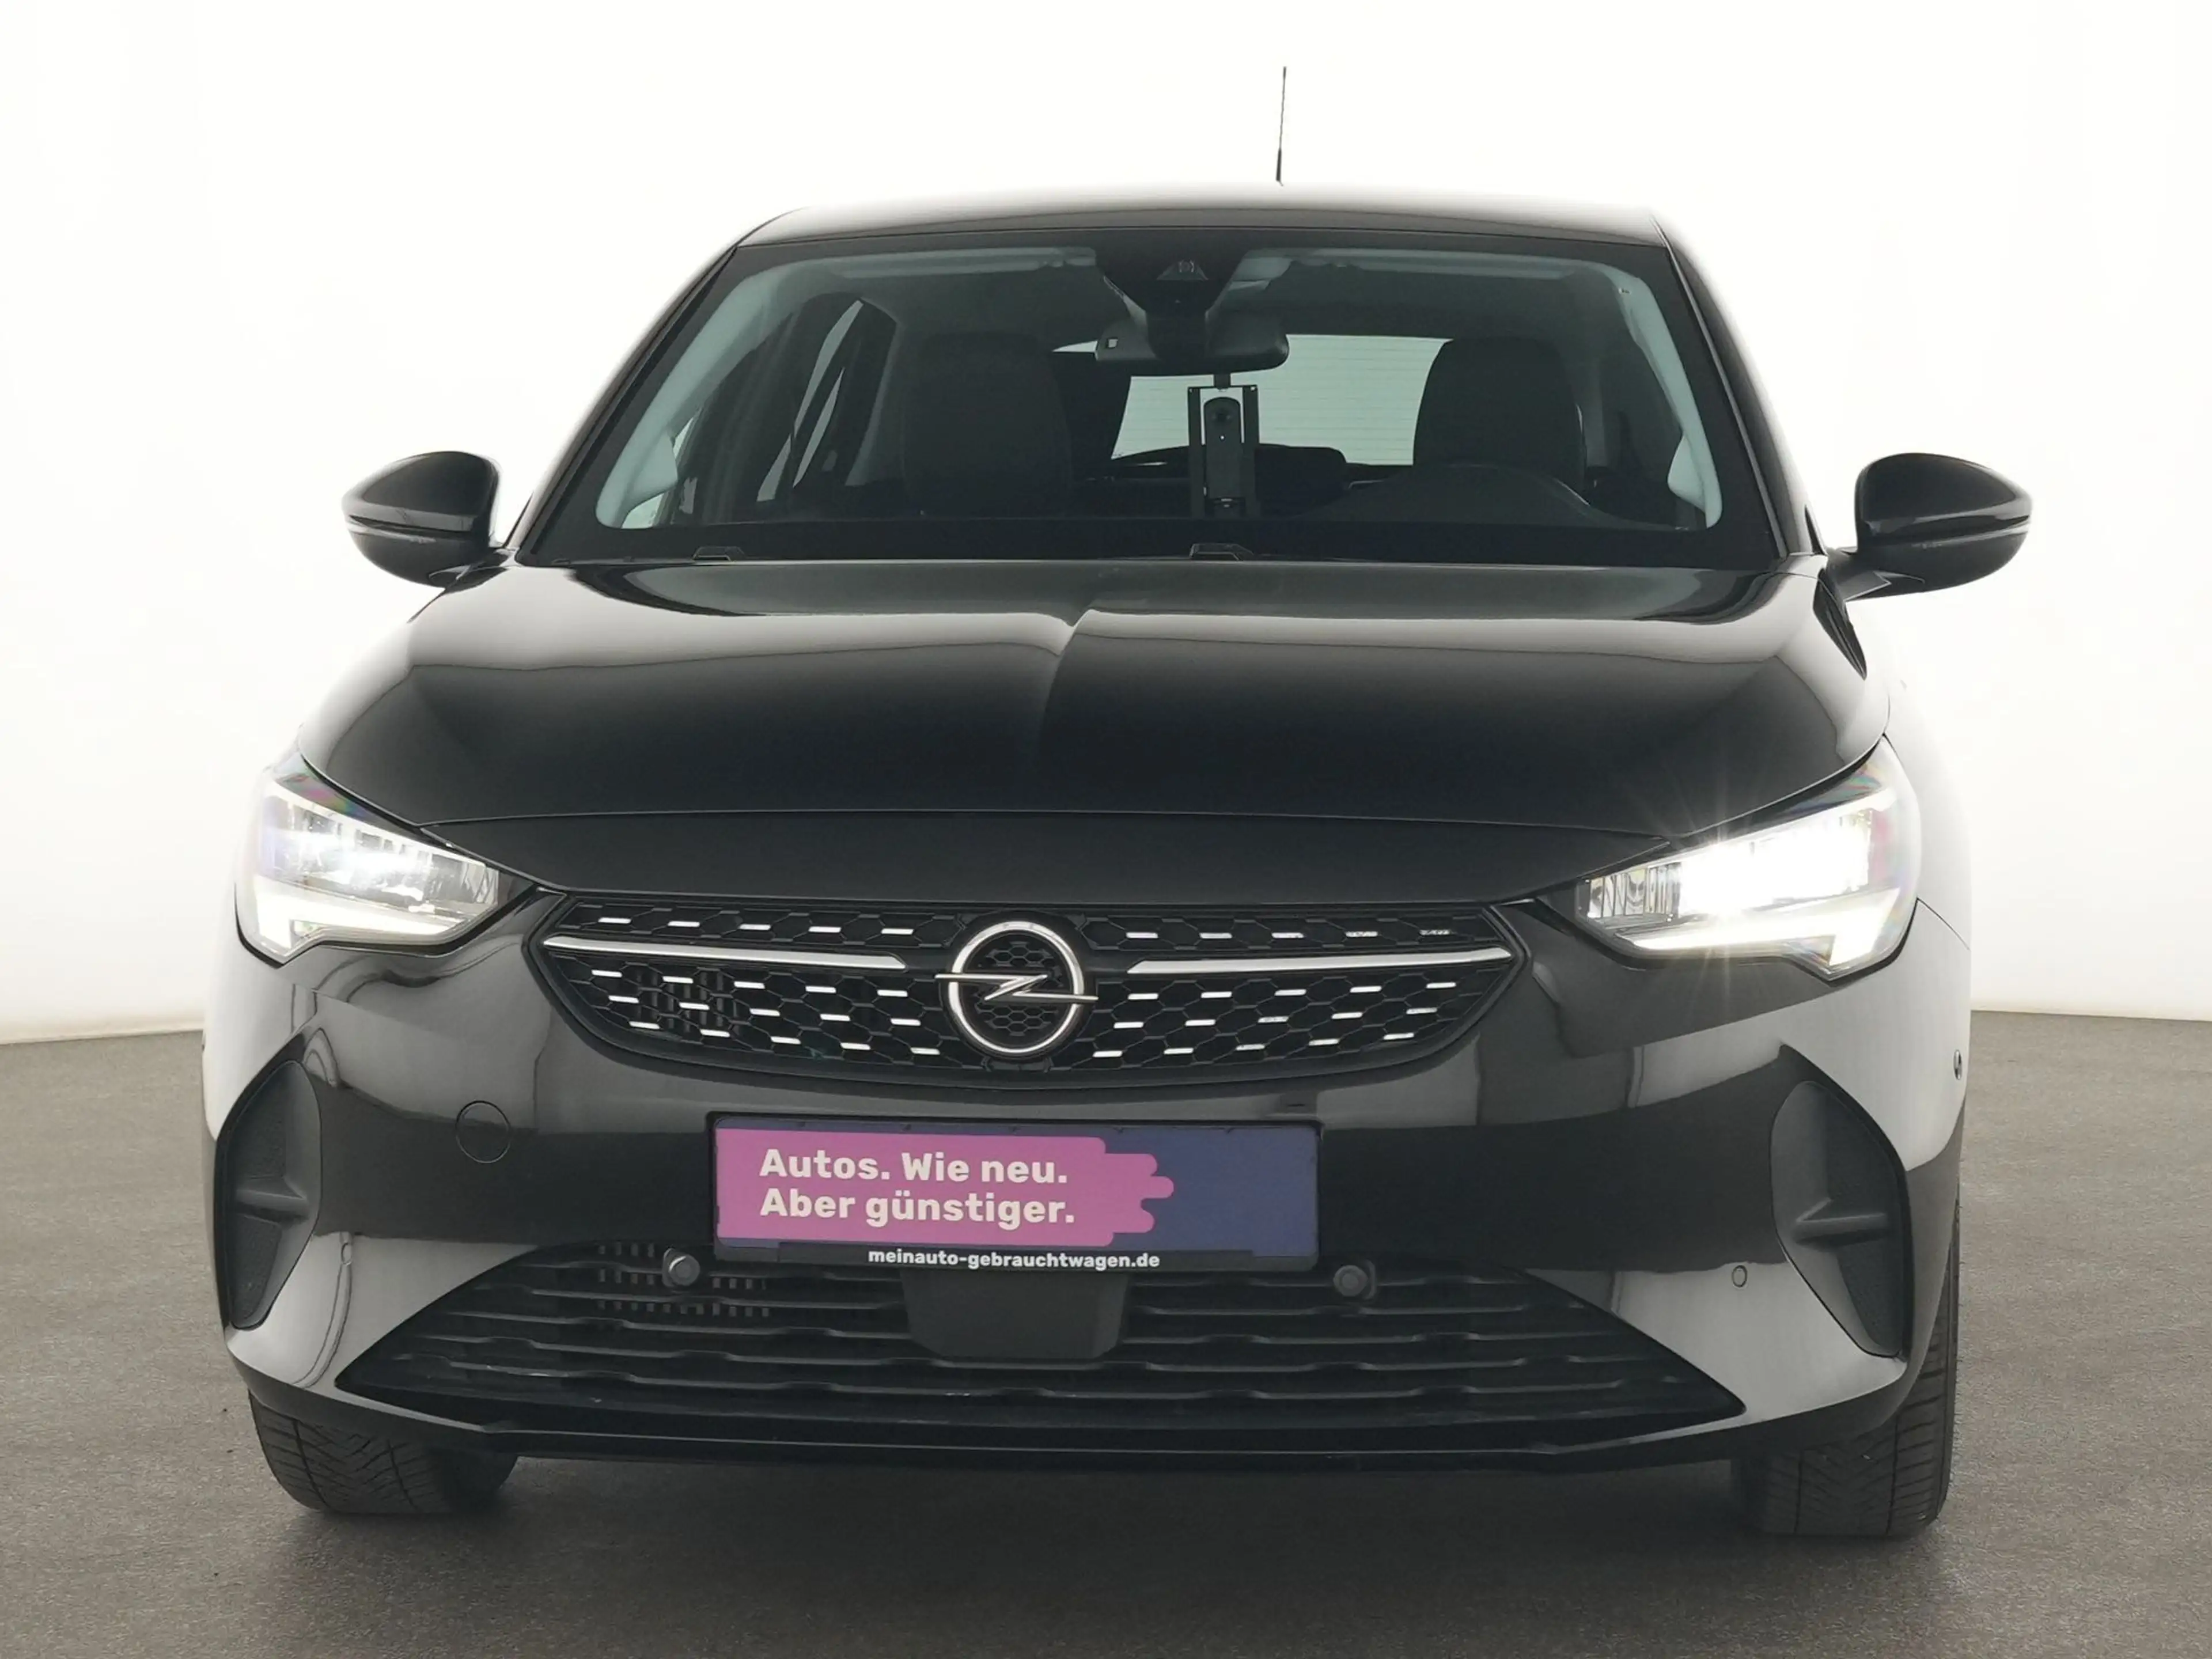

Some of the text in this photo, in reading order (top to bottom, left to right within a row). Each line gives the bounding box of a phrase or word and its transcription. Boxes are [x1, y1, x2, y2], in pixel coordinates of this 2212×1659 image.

[759, 1149, 1067, 1184] Autos. Wie neu.
[759, 1188, 1075, 1231] Aber günstiger.
[868, 1248, 1160, 1271] meinauto-gebrauchtwagen.de
